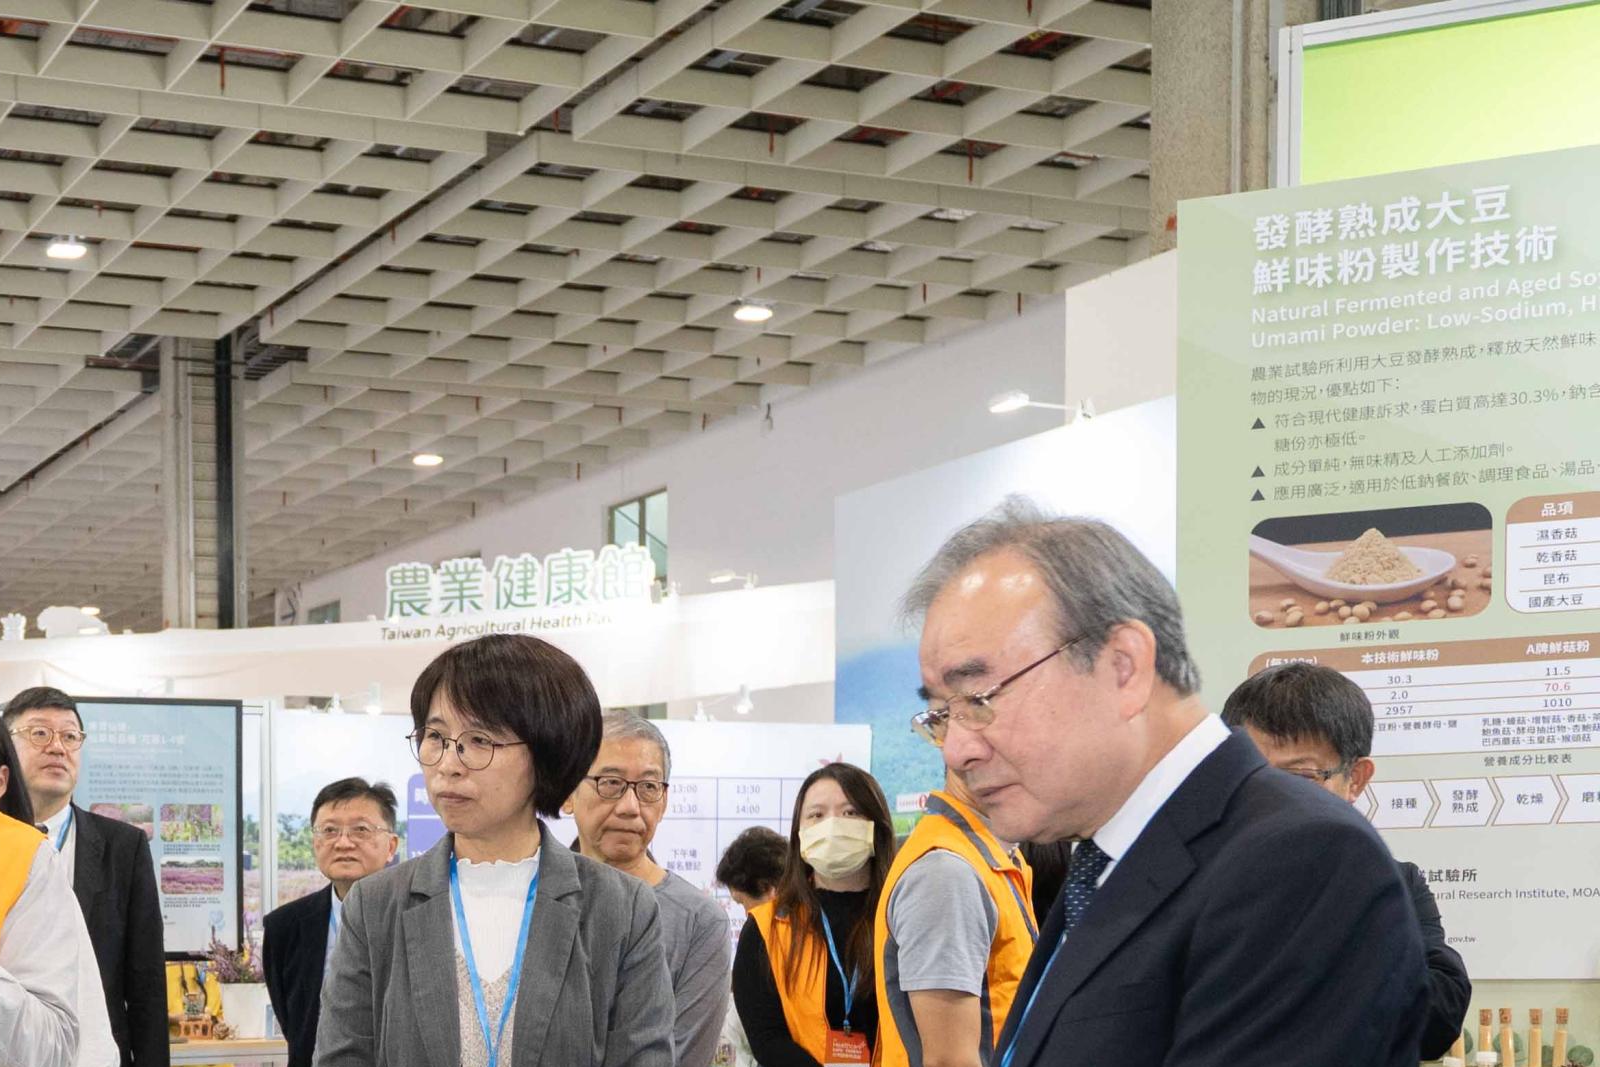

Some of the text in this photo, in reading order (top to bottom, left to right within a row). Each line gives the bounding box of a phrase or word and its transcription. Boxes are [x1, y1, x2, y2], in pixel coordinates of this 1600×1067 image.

[1252, 184, 1512, 251] 發酵熟成大豆
[1252, 225, 1558, 295] 鮮味粉製作技術
[1252, 270, 1600, 325] Natural Fermented and Aged So
[1252, 294, 1600, 350] Umami Powder: Low-Sodium, H
[1541, 501, 1574, 517] 品項
[1536, 550, 1578, 563] 乾香菇
[387, 548, 648, 618] 農業健康館
[1543, 573, 1570, 585] 昆布
[1528, 593, 1584, 608] 國產大豆
[381, 627, 431, 641] Taiwan
[435, 618, 527, 640] Agricultural
[530, 614, 583, 630] Health
[1340, 629, 1400, 642] 鮮味粉外觀
[1361, 648, 1440, 664] 本技術鮮味粉
[1387, 666, 1571, 685] 30.3 11.5
[1391, 682, 1571, 700] 2.0 70.6
[1386, 698, 1572, 716] 2957 1010
[1484, 753, 1573, 767] 營養成分比較表
[1391, 798, 1417, 809] 接種
[1452, 802, 1479, 813] 熟成
[1516, 794, 1543, 805] 乾燥
[1452, 790, 1479, 801] 發酵
[1459, 888, 1511, 900] Research
[1516, 887, 1570, 900] Institute,
